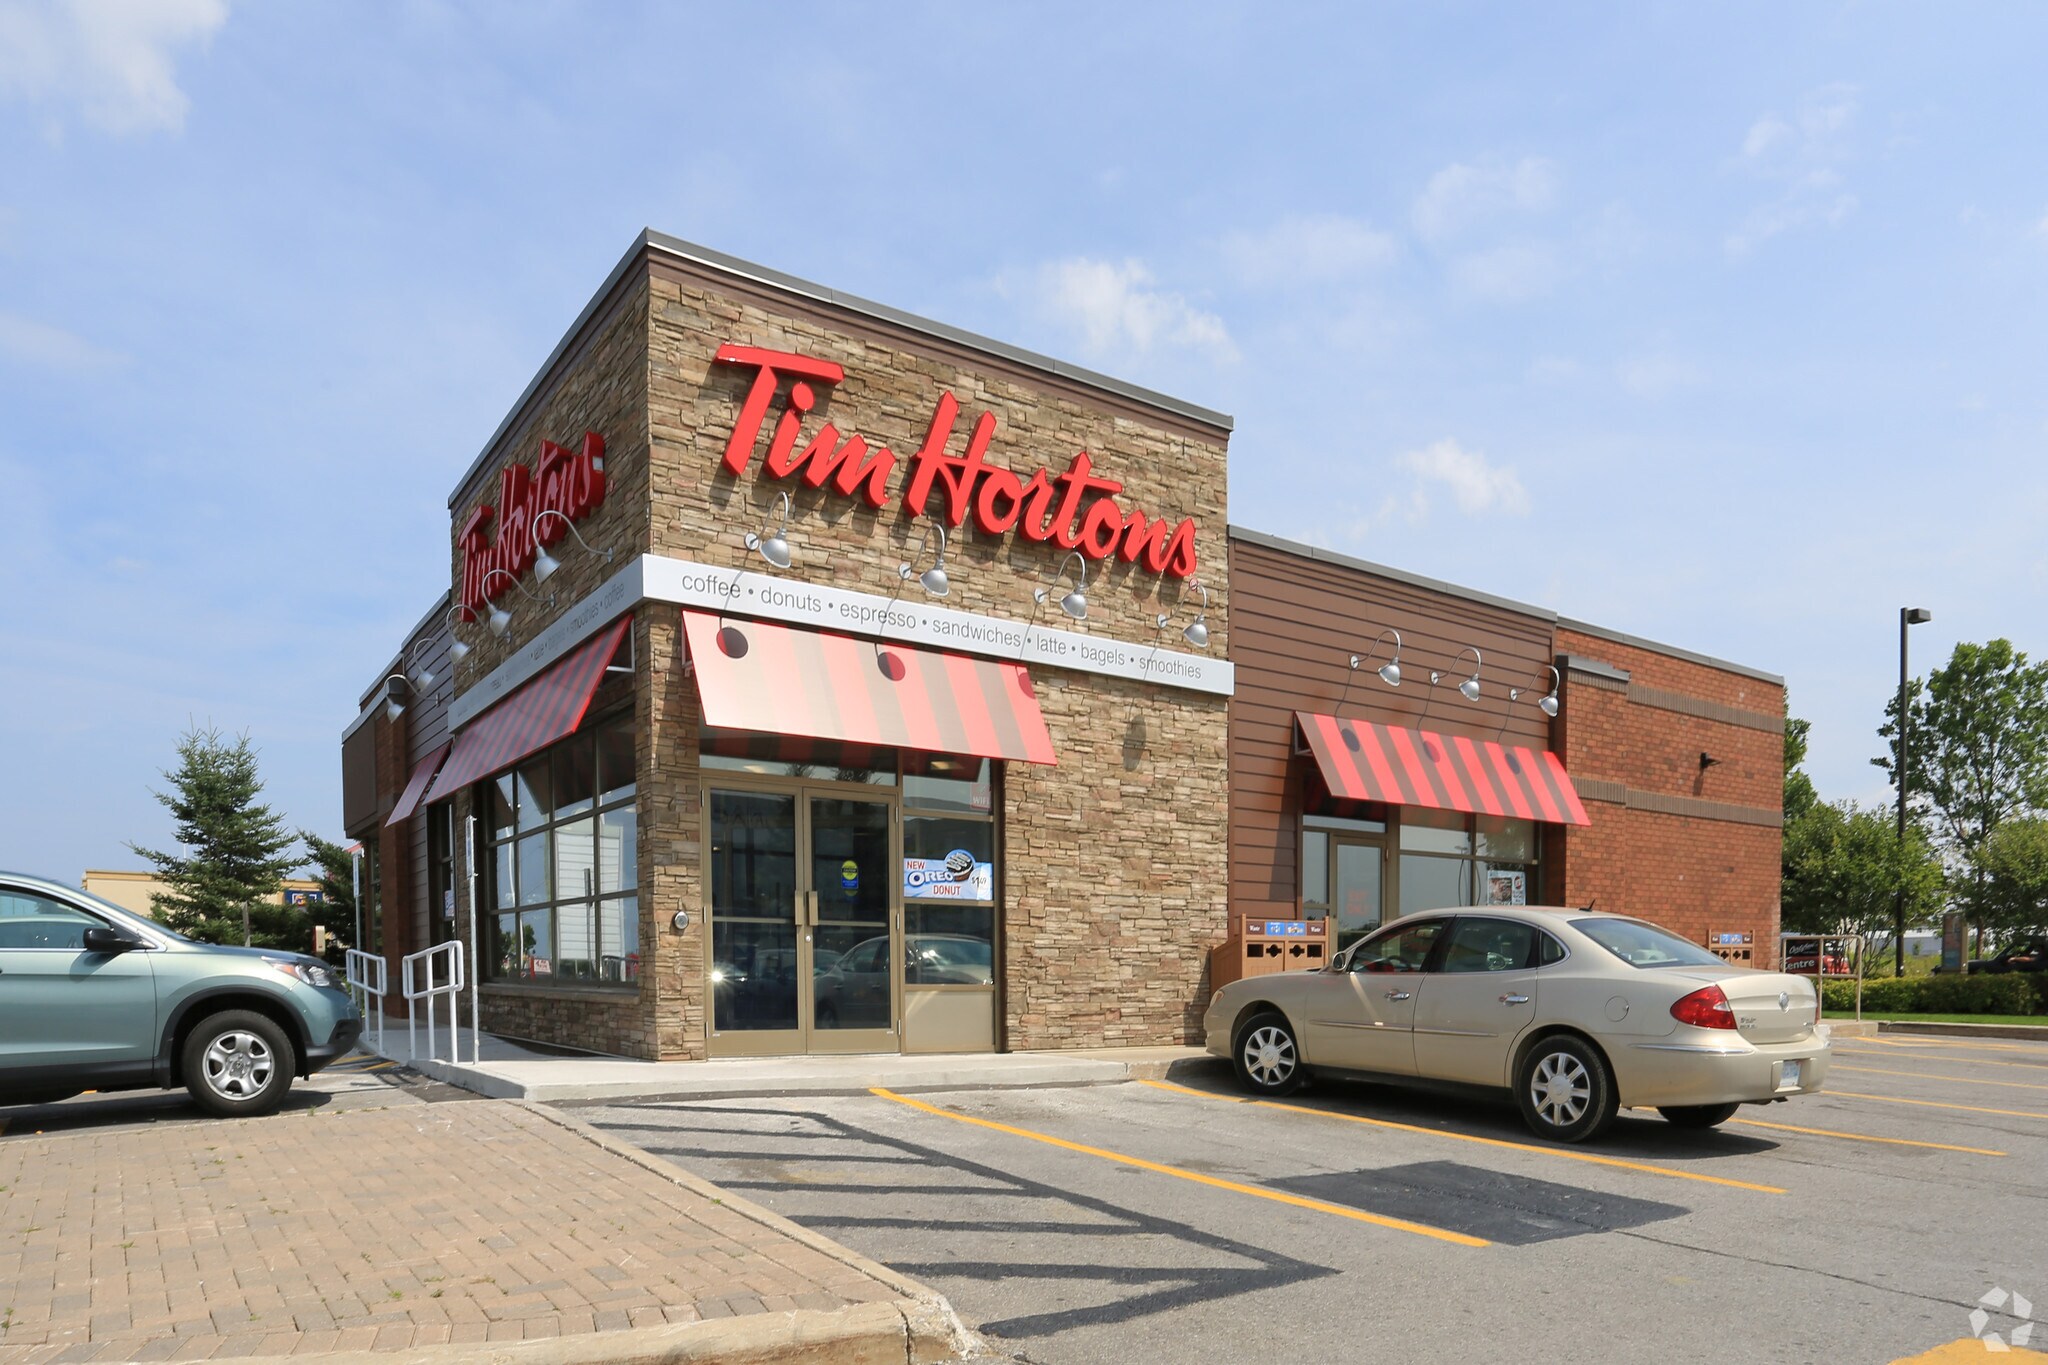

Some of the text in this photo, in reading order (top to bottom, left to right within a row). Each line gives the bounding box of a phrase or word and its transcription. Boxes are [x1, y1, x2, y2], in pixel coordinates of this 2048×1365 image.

[715, 343, 1198, 578] Tim Hortons
[458, 431, 606, 622] Tim Hortons
[682, 574, 1202, 679] coffee donuts espresso sandwiches latte bagels smoothies
[906, 860, 926, 870] NEW
[908, 870, 954, 888] OREO
[933, 884, 962, 896] DONUT
